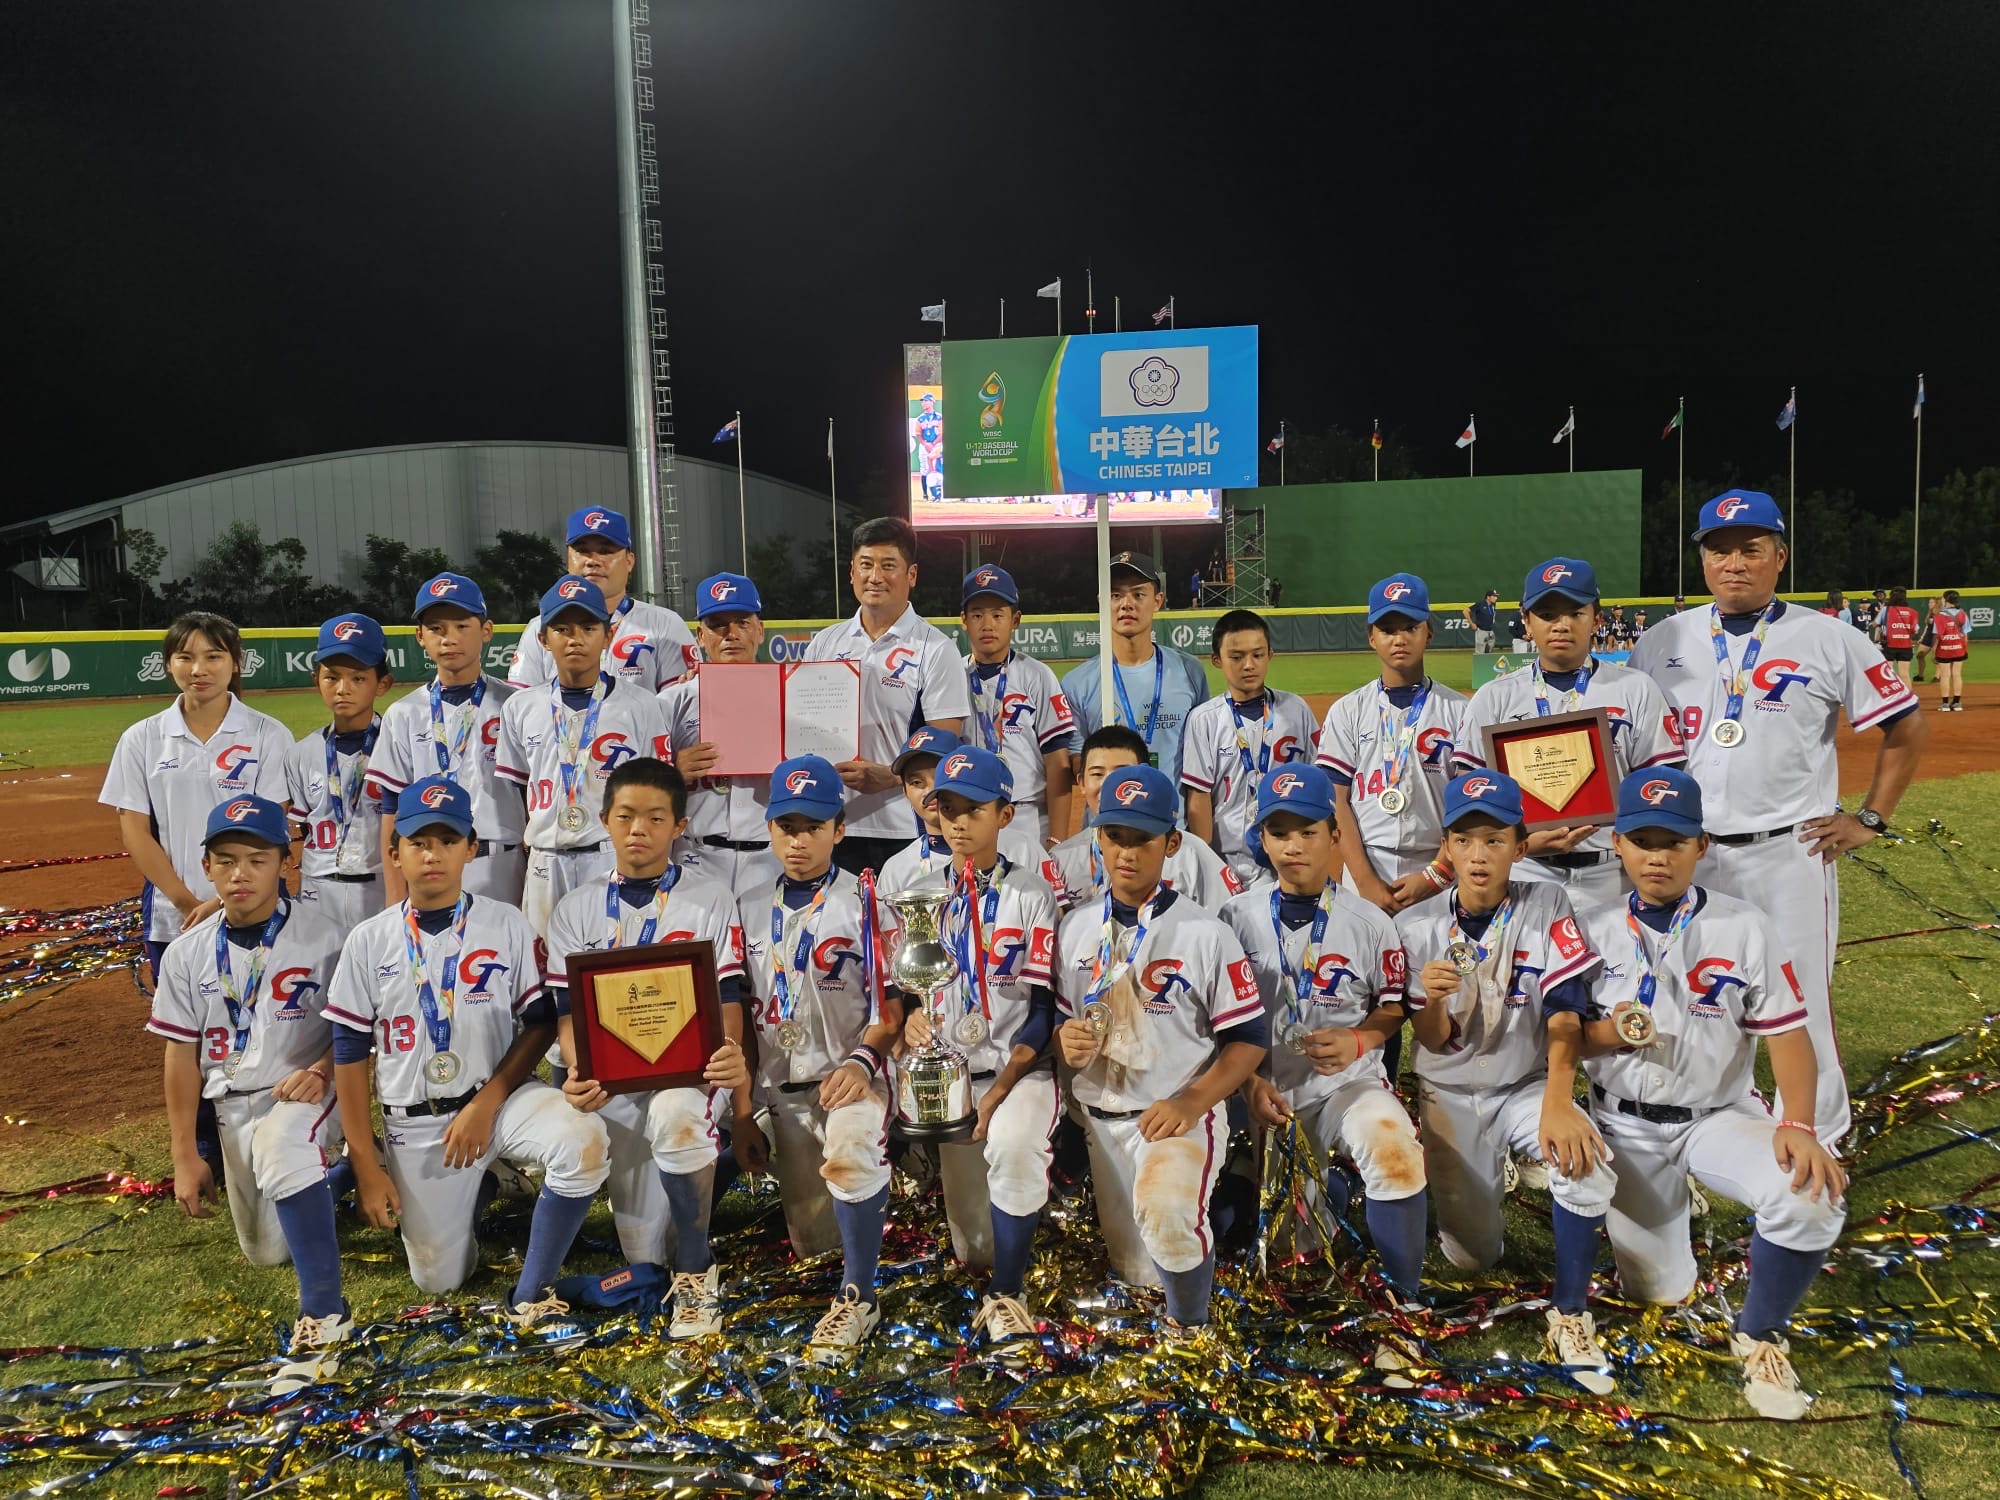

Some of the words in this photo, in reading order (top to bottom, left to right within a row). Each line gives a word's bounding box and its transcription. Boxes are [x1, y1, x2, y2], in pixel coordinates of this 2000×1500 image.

[983, 441, 1019, 449] BASEBALL
[1089, 422, 1220, 461] 中華台北
[972, 449, 998, 457] WORLD
[999, 448, 1013, 456] CUP
[1099, 463, 1162, 480] CHINESE
[1165, 461, 1212, 477] TAIPEI
[1444, 618, 1470, 630] 275
[881, 676, 906, 684] Chinese
[46, 683, 90, 692] SPORTS
[881, 681, 905, 689] Taipei
[1753, 700, 1790, 708] Chinese
[1754, 705, 1787, 713] Taipei
[1144, 714, 1181, 722] BSEBALL
[1356, 769, 1385, 801] 14
[463, 992, 494, 1000] Chinese
[1311, 994, 1344, 1002] Chinese
[464, 997, 492, 1006] Taipei
[1142, 1001, 1176, 1010] Chinese
[1312, 1000, 1341, 1009] Taipei
[1143, 1008, 1174, 1016] Taipei
[1687, 1003, 1727, 1013] Chinese
[274, 1009, 309, 1017] Chinese
[1689, 1010, 1724, 1019] Taipei
[275, 1014, 306, 1022] Taipei
[379, 1014, 416, 1055] 13
[205, 1027, 229, 1061] 3
